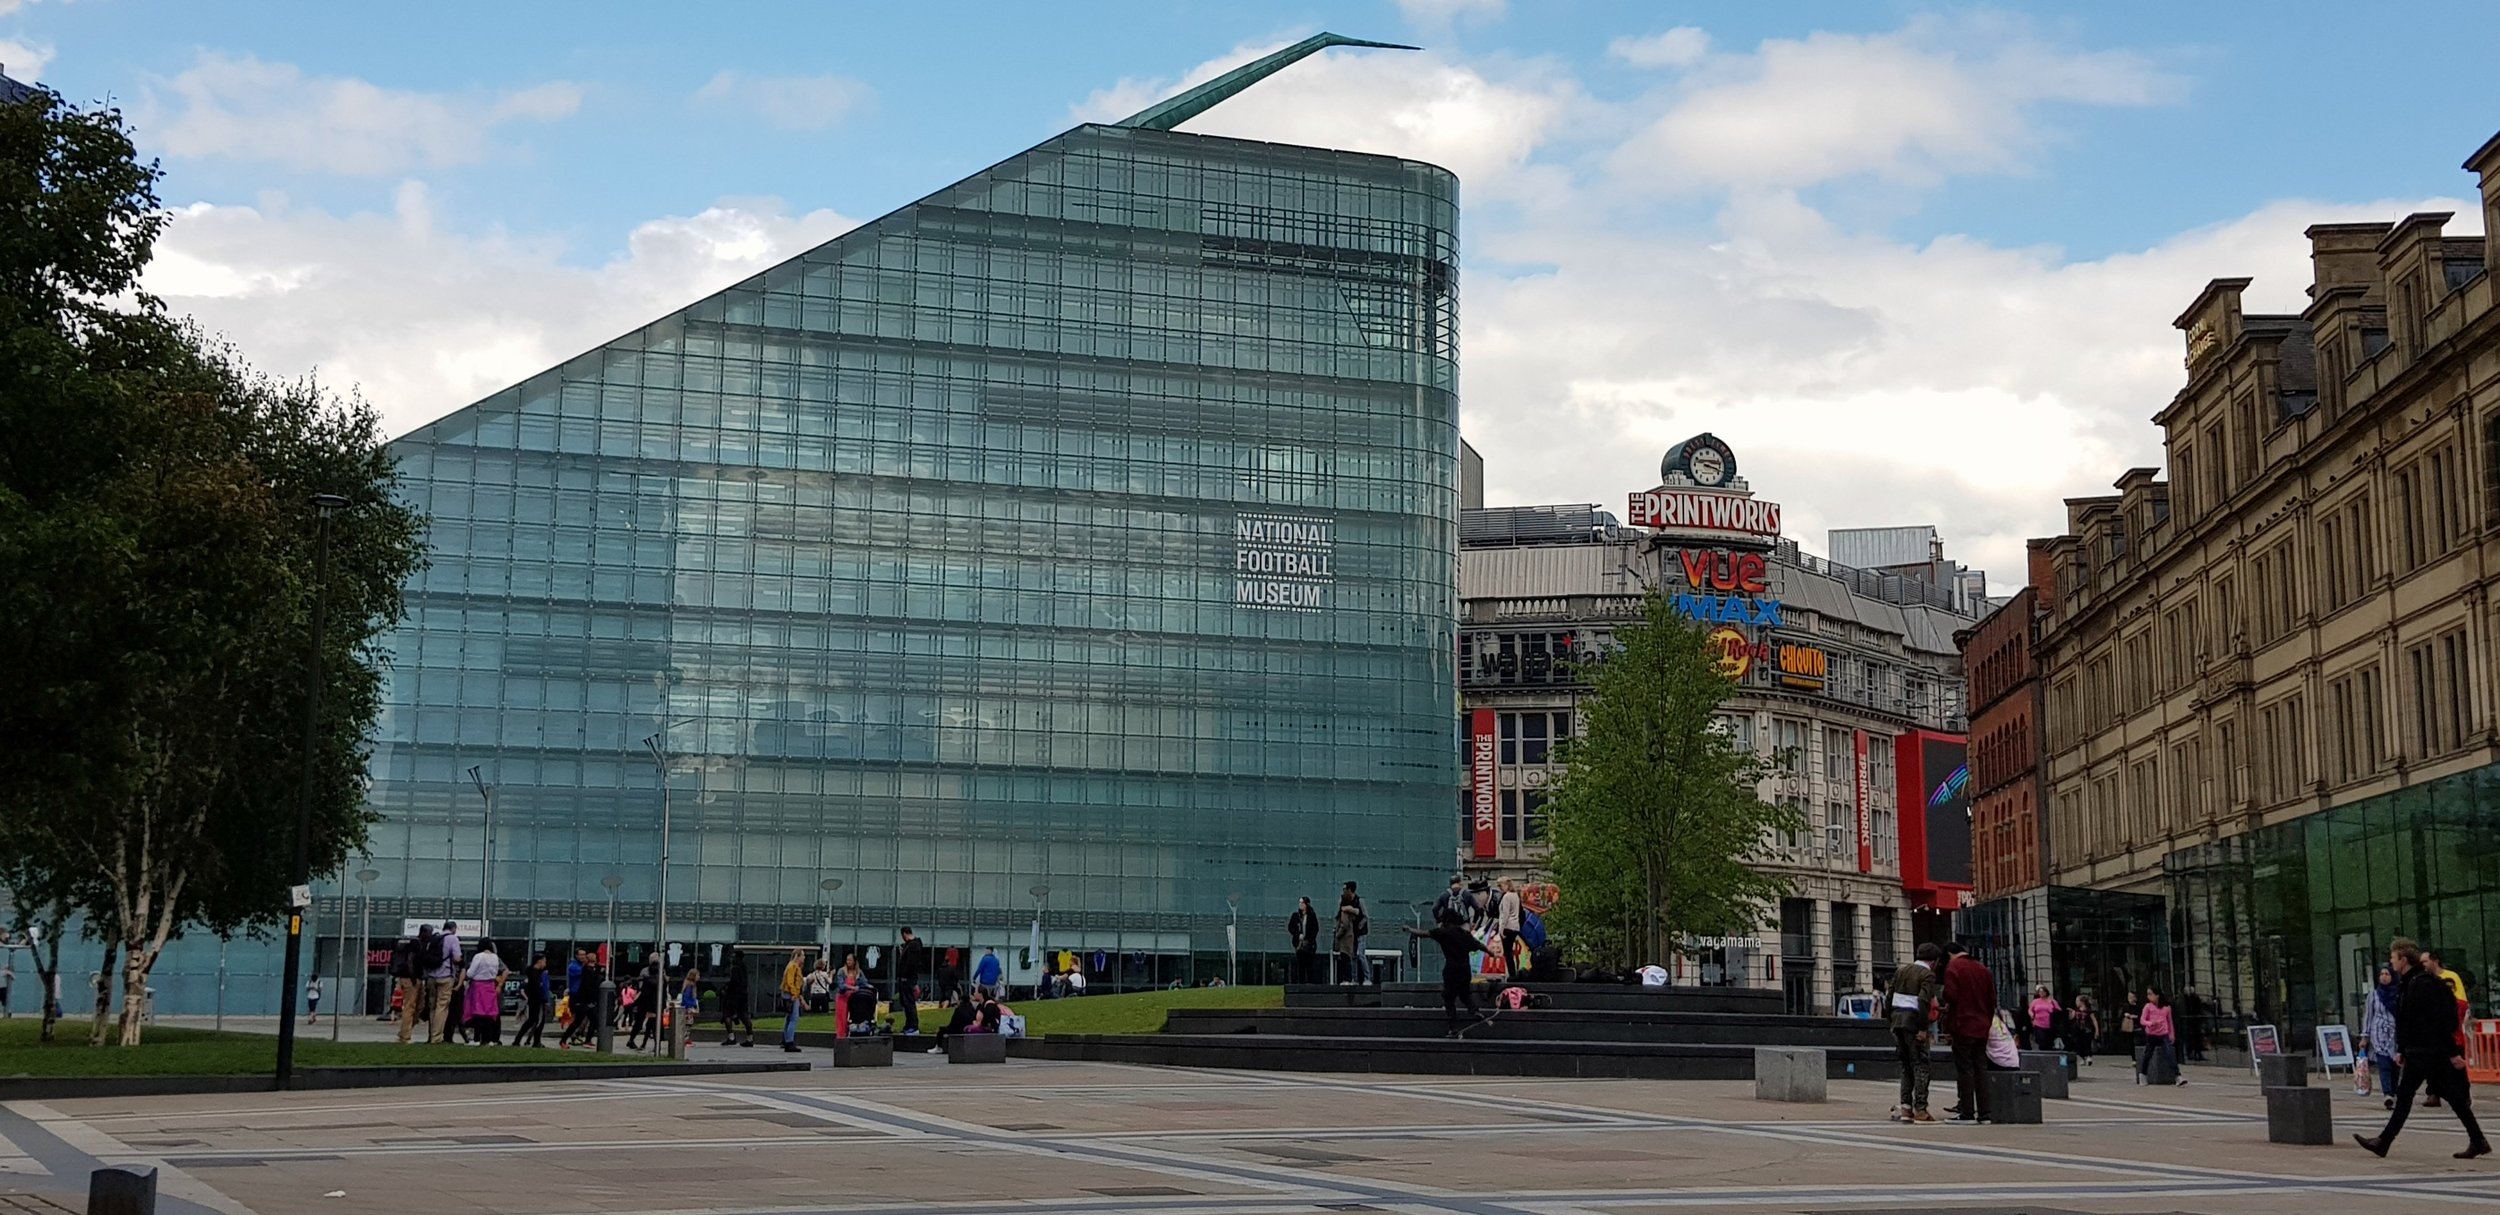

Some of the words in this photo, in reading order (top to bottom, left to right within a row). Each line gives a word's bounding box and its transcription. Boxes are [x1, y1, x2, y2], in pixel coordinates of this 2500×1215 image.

[1631, 493, 1645, 524] THE
[1645, 493, 1780, 535] PRINTWORKS
[1237, 519, 1332, 547] NATIONAL
[1237, 549, 1332, 577] FOOTBALL
[1236, 580, 1321, 607] MUSEUM
[1780, 644, 1825, 677] CHIQUITO
[1475, 734, 1493, 742] THE
[1475, 743, 1493, 831] PRINTWORKS
[1859, 762, 1870, 847] PRINTWORKS
